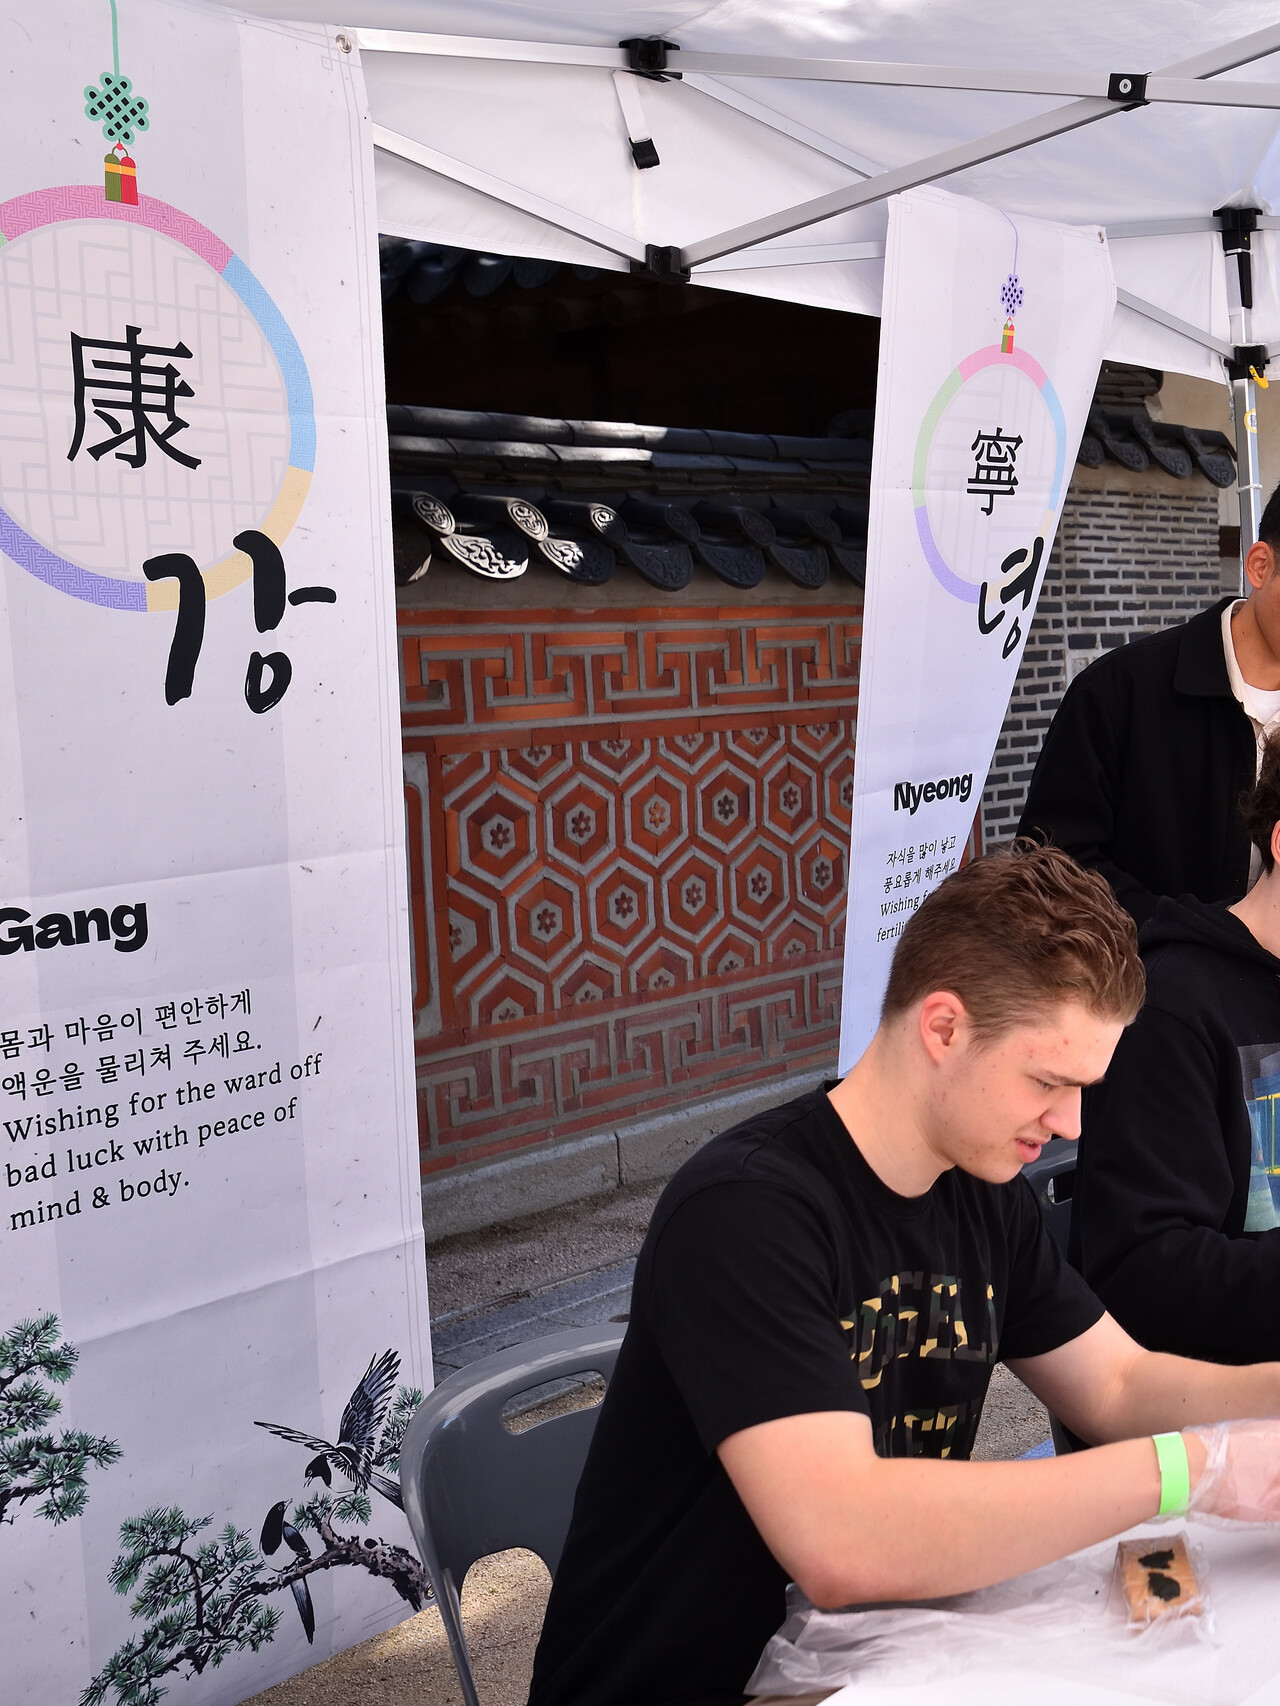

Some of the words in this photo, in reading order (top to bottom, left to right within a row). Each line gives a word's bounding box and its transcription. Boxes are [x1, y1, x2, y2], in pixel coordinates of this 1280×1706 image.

[67, 324, 202, 470] 康
[966, 426, 1024, 516] 寧
[143, 529, 337, 714] 강
[894, 773, 973, 816] Nyeong
[883, 867, 922, 894] 풍요롭게
[886, 846, 916, 868] 자식을
[919, 839, 938, 860] 많이
[941, 835, 957, 854] 낳고
[0, 902, 149, 956] Gang
[880, 896, 920, 917] Wishing
[0, 1023, 55, 1060] 몸과
[65, 1007, 145, 1046] 마음이
[155, 988, 252, 1031] 편안하게
[1, 1062, 85, 1101] 액운을
[95, 1042, 173, 1085] 물리쳐
[183, 1029, 262, 1066] 주세요.
[3, 1102, 120, 1144] Wishing
[129, 1091, 168, 1117] for
[176, 1081, 217, 1107] the
[224, 1061, 283, 1096] ward
[290, 1053, 323, 1081] off
[5, 1154, 57, 1188] bad
[67, 1139, 126, 1174] luck
[133, 1124, 189, 1157] with
[198, 1111, 266, 1148] peace
[273, 1096, 299, 1124] of
[10, 1190, 82, 1231] mind
[92, 1185, 112, 1210] &
[119, 1168, 190, 1204] body.
